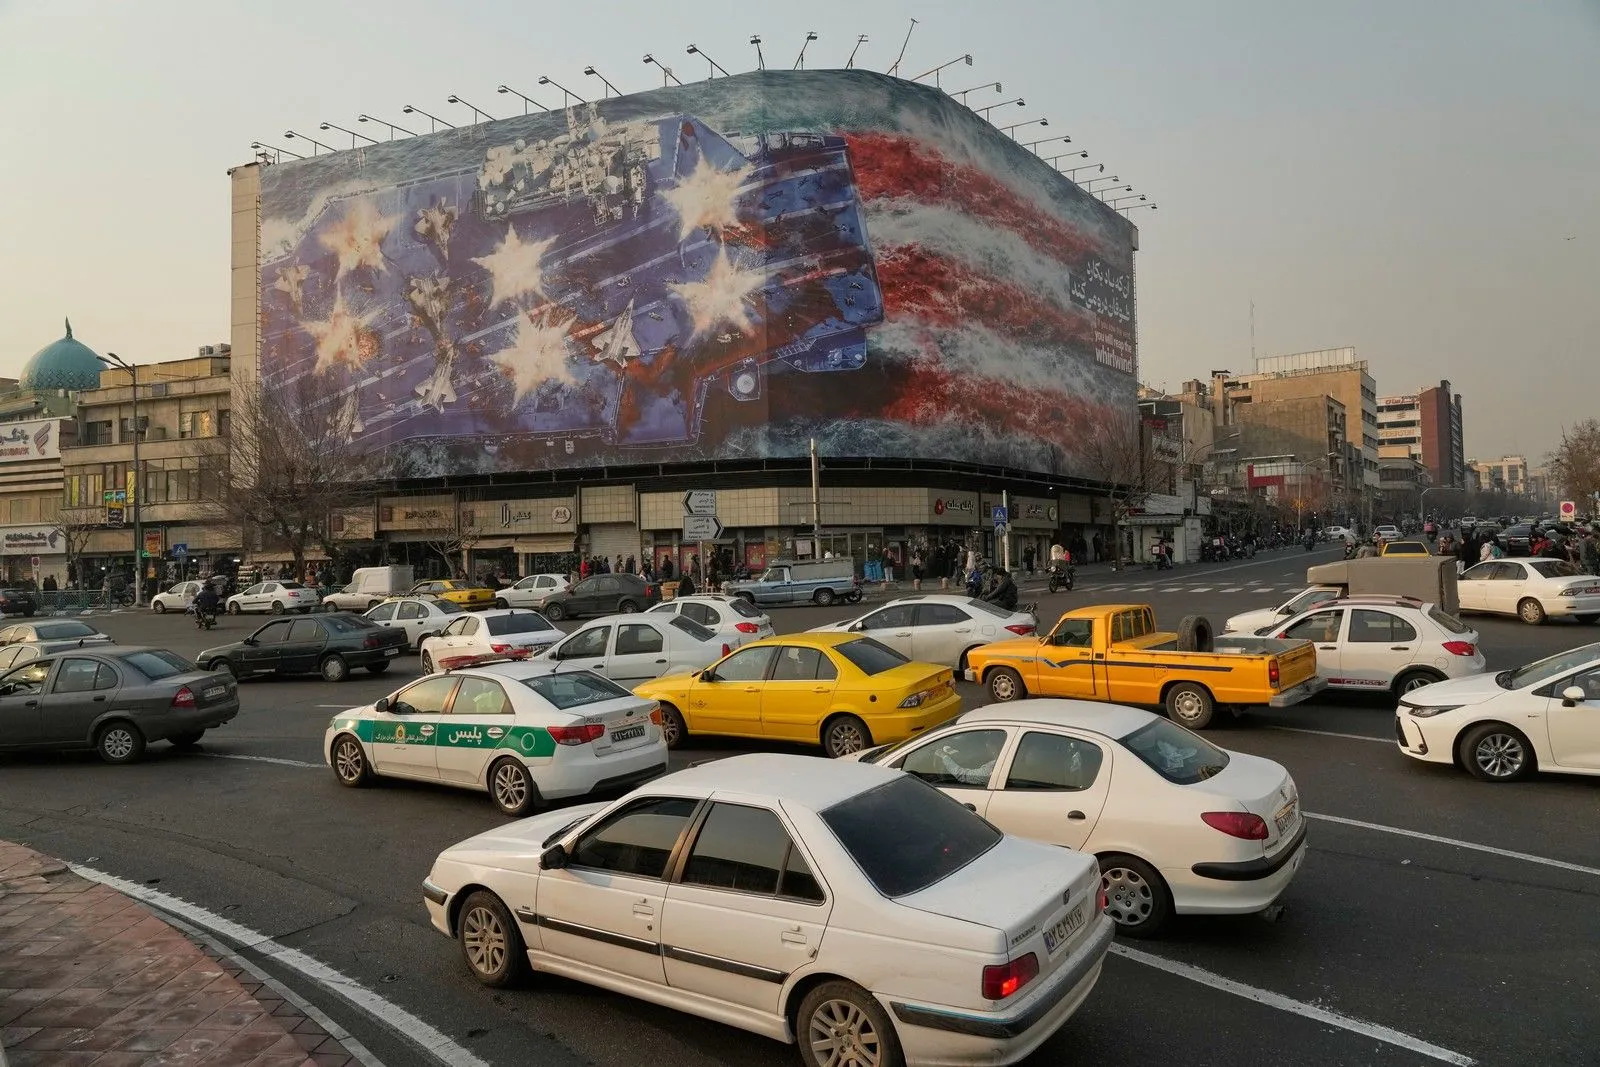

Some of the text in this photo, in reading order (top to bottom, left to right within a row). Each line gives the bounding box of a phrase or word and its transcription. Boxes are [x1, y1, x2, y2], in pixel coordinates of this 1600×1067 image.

[1094, 330, 1132, 354] you will reap the
[1095, 344, 1133, 373] whirlwind
[513, 511, 531, 522] کفش
[946, 499, 974, 514] بانک ملت
[449, 725, 482, 745] پلیس
